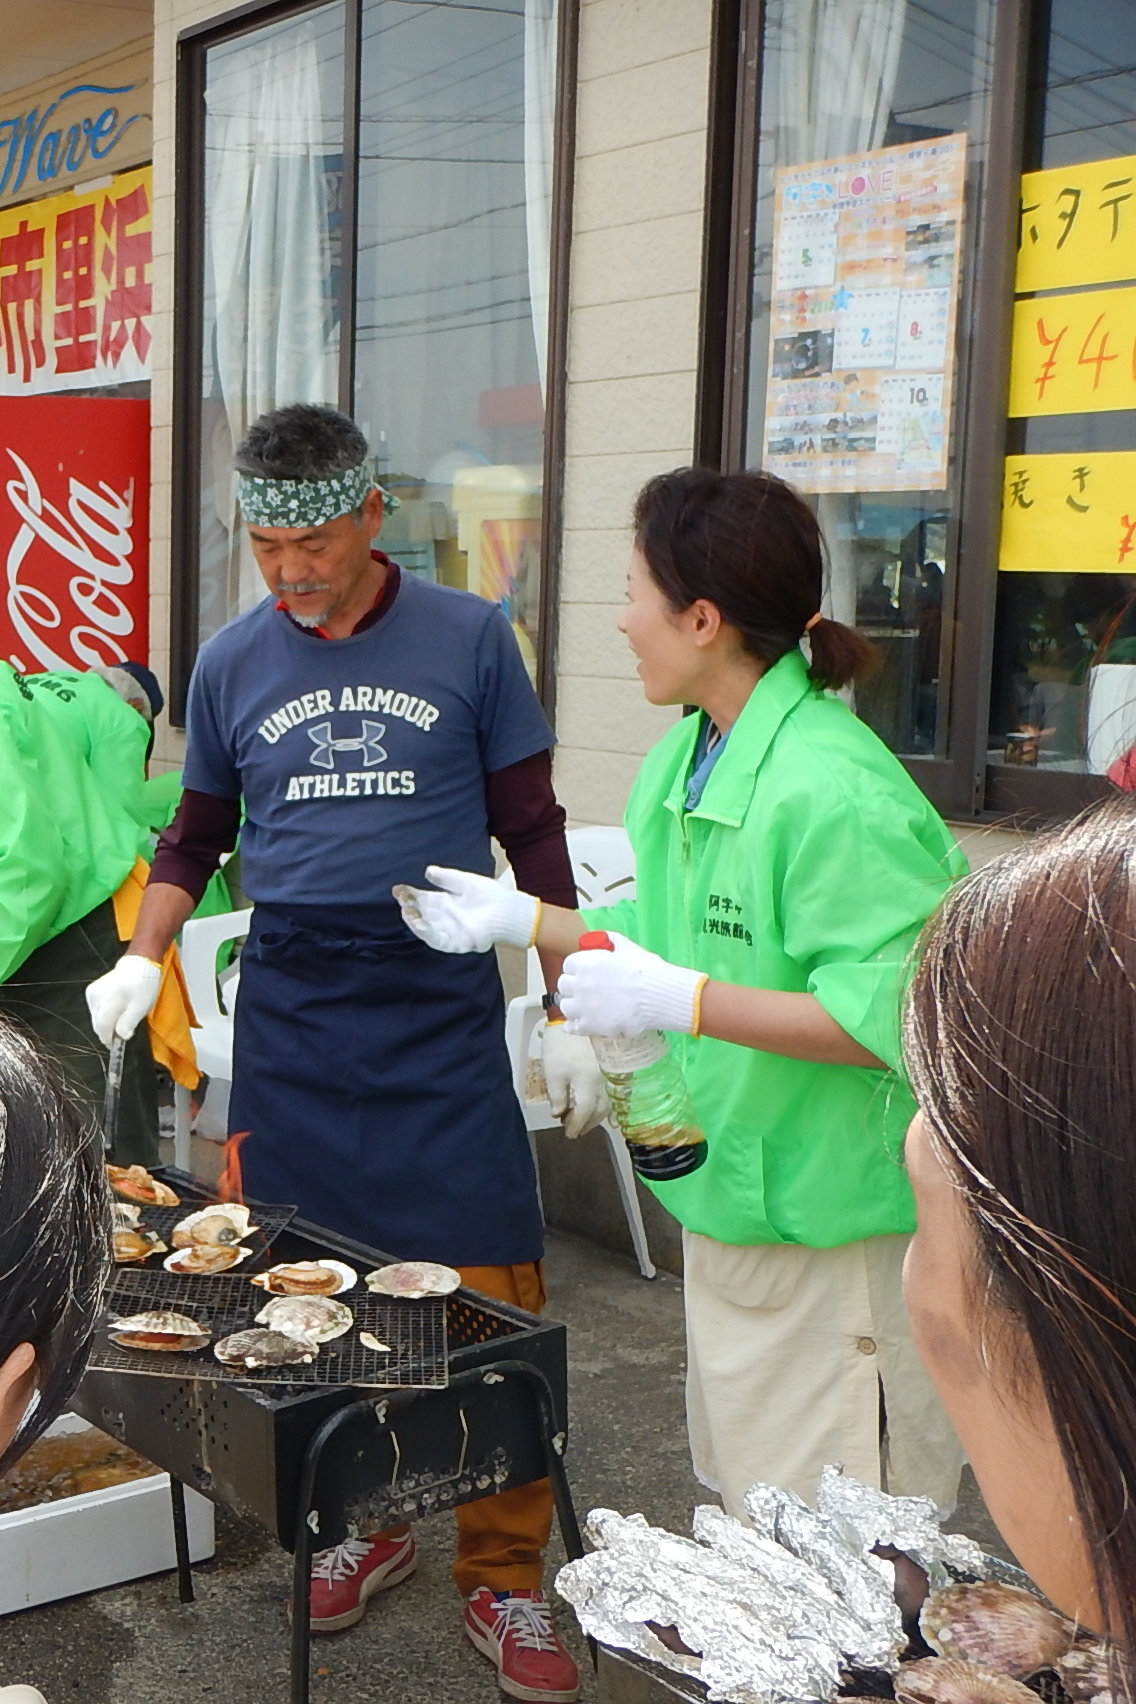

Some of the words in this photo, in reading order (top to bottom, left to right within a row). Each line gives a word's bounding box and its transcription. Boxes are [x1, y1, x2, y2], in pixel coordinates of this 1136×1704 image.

[1034, 312, 1136, 401] ¥4
[258, 689, 334, 745] UNDER
[339, 685, 440, 732] ARMOUR
[285, 770, 416, 801] ATHLETICS
